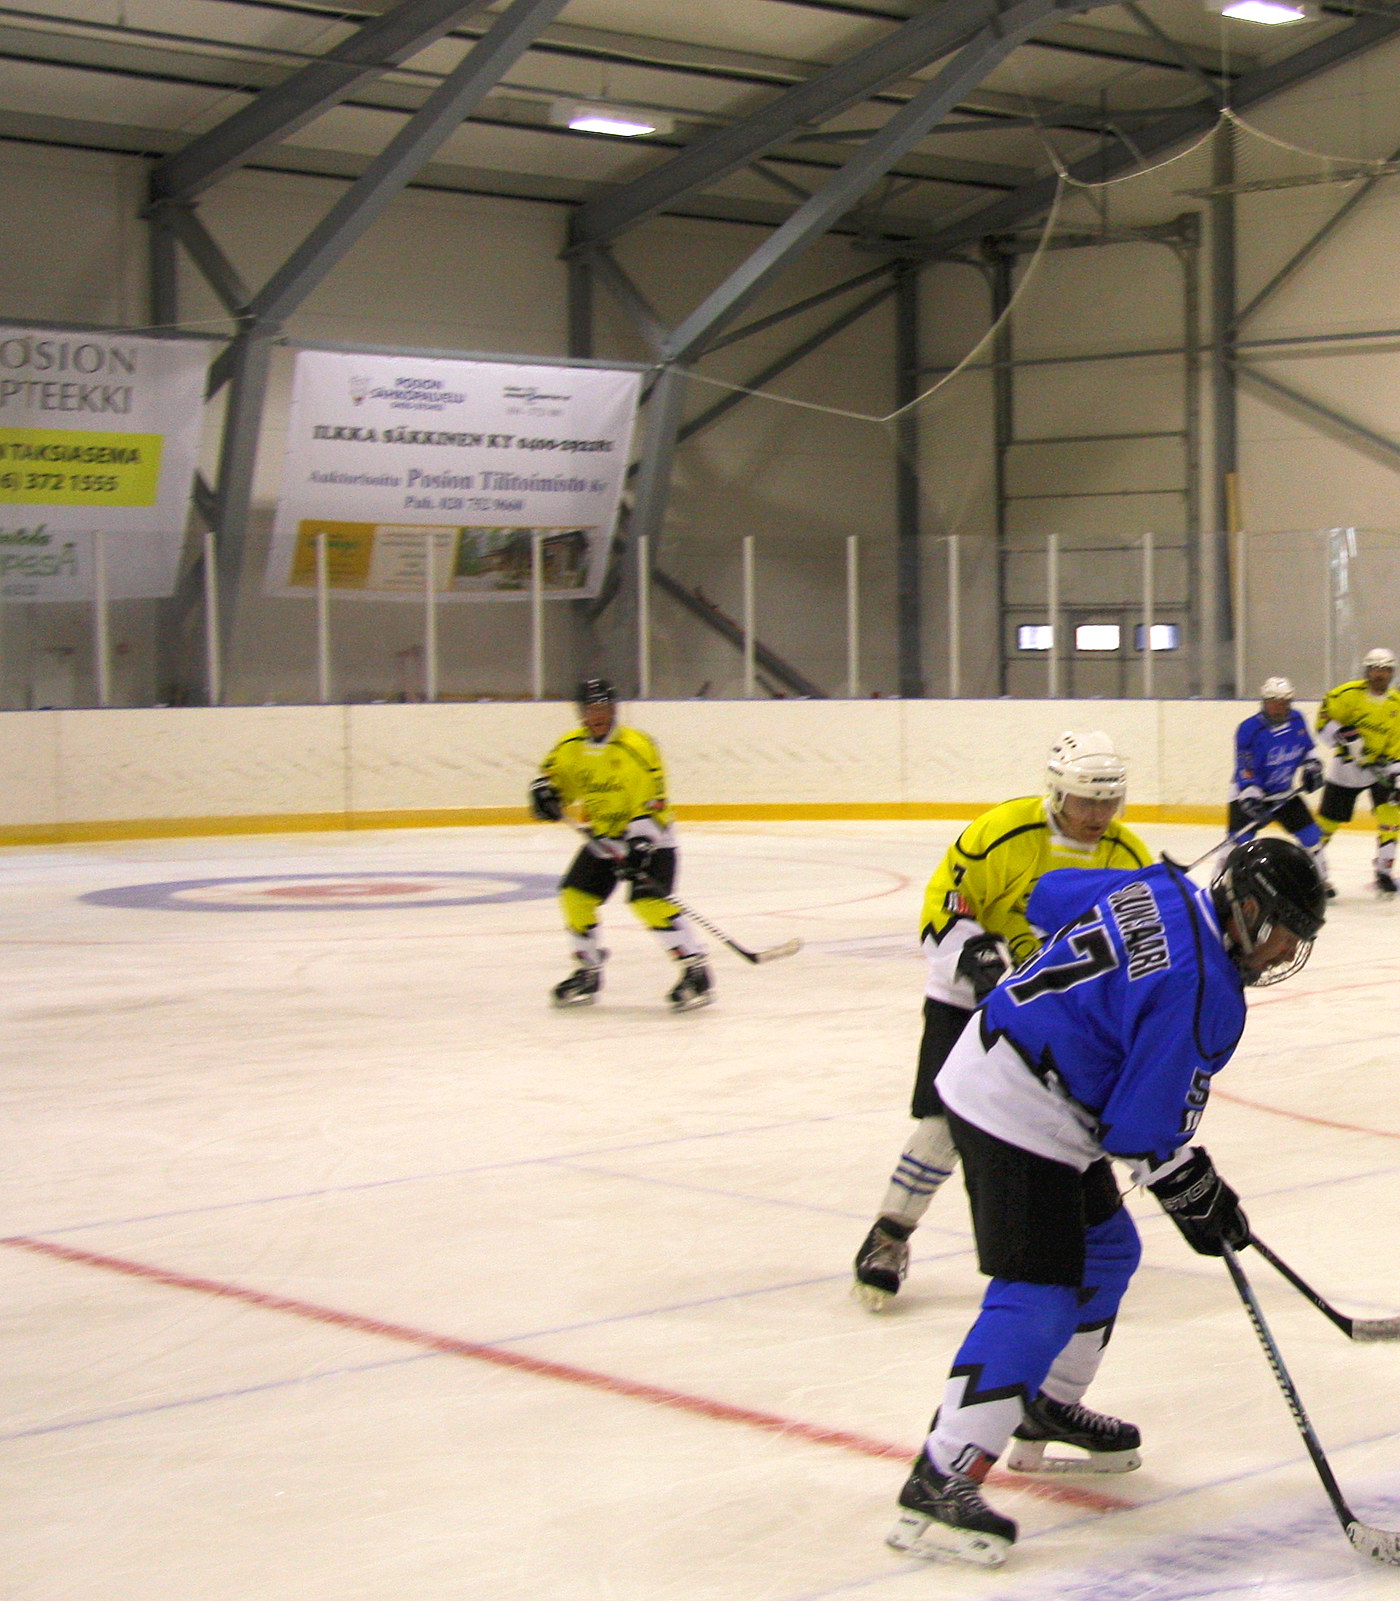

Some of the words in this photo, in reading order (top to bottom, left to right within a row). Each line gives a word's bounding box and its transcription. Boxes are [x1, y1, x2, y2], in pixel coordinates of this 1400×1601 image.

[311, 424, 377, 443] ILKKA
[487, 434, 517, 450] KY
[25, 472, 64, 491] 372
[405, 468, 474, 490] Posion
[952, 863, 968, 888] 7
